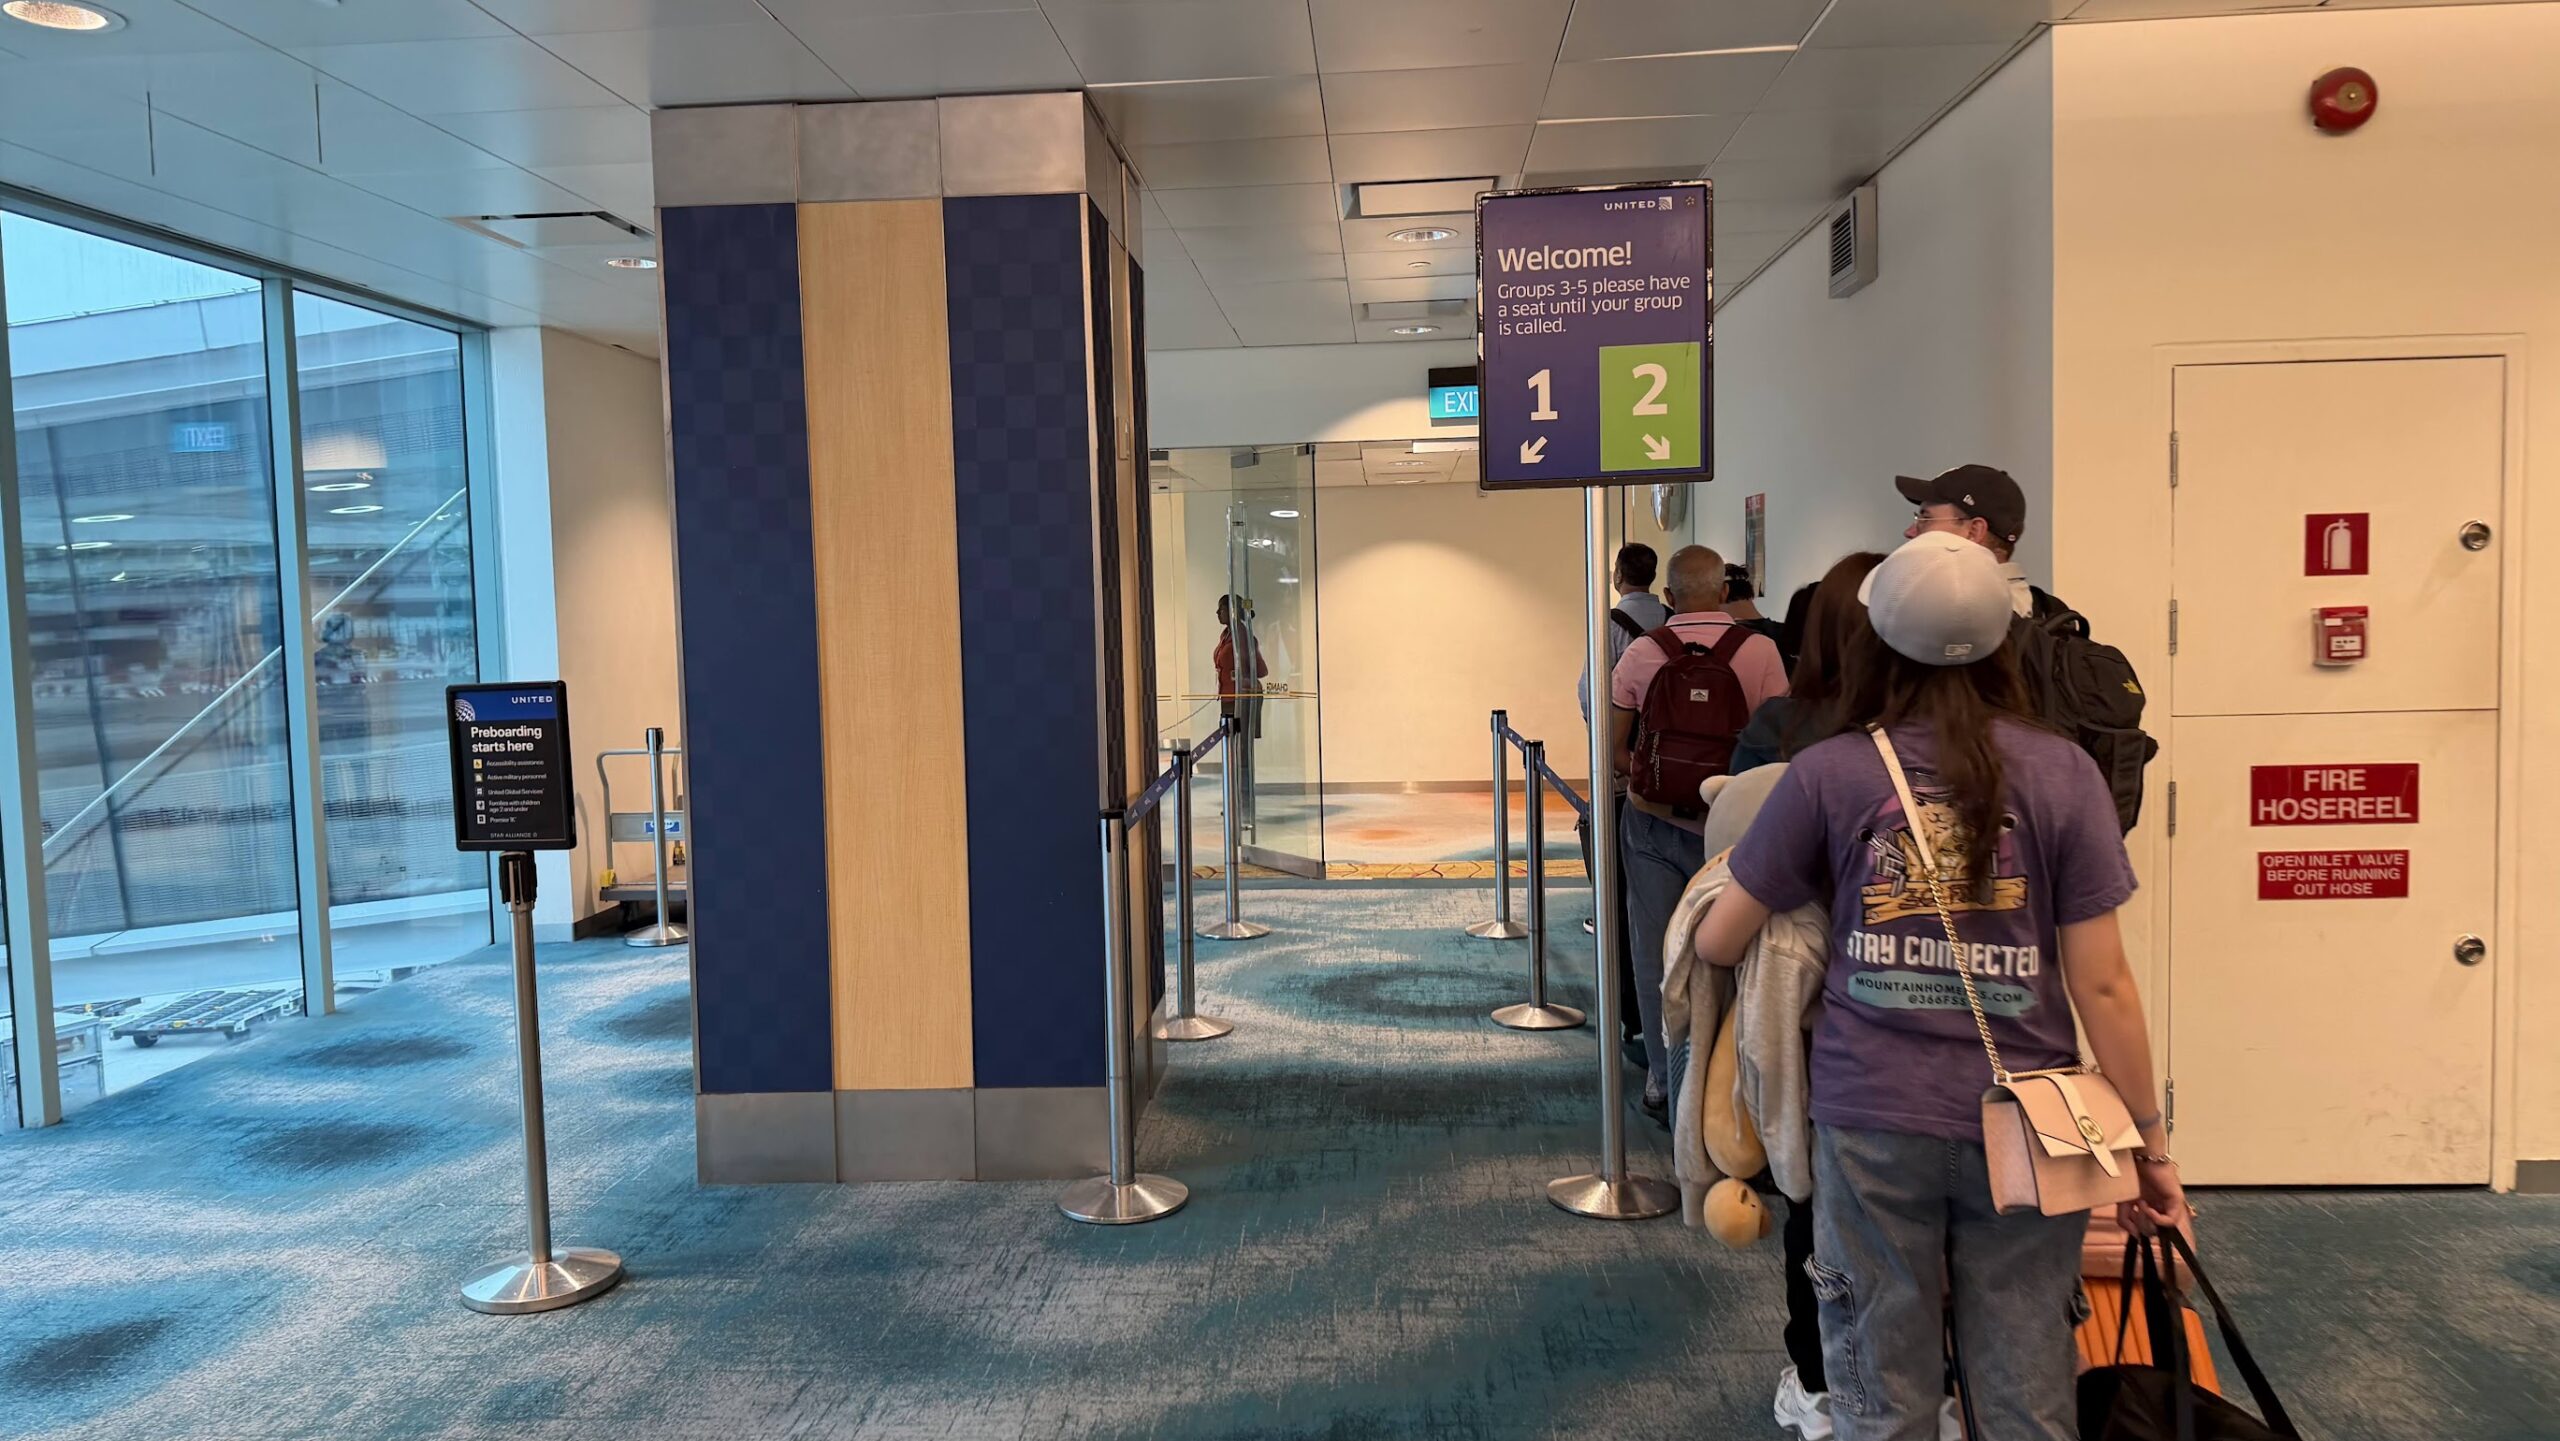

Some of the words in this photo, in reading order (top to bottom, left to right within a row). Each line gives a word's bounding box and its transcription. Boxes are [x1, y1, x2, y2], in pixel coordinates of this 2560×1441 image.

[1604, 200, 1656, 211] UNITED
[1498, 241, 1632, 272] Welcome!
[1498, 283, 1555, 300] Groups
[1560, 280, 1588, 295] 3-5
[1593, 277, 1645, 295] please
[1650, 275, 1690, 291] have
[1498, 304, 1508, 317] a
[1512, 301, 1545, 317] seat
[1550, 298, 1586, 315] until
[1592, 298, 1629, 315] your
[1634, 295, 1682, 312] group
[1499, 320, 1511, 335] is
[1516, 317, 1566, 335] called.
[1527, 368, 1558, 421] 1
[1632, 362, 1668, 416] 2
[511, 695, 553, 704] UNITED
[470, 725, 543, 740] Preboarding
[471, 741, 506, 753] starts
[507, 740, 534, 752] here
[521, 773, 547, 781] personnel
[2303, 769, 2367, 792] FIRE
[2258, 796, 2412, 821] HOSEREEL
[2263, 855, 2305, 868] OPEN
[2309, 854, 2352, 867] INLET
[2357, 853, 2405, 866] VALVE
[2266, 868, 2329, 881] BEFORE
[2332, 868, 2400, 880] RUNNING
[2293, 883, 2326, 895] OUT
[2330, 882, 2373, 894] HOSE
[1854, 976, 2023, 1003] MOUNTAINHOMES.COM
